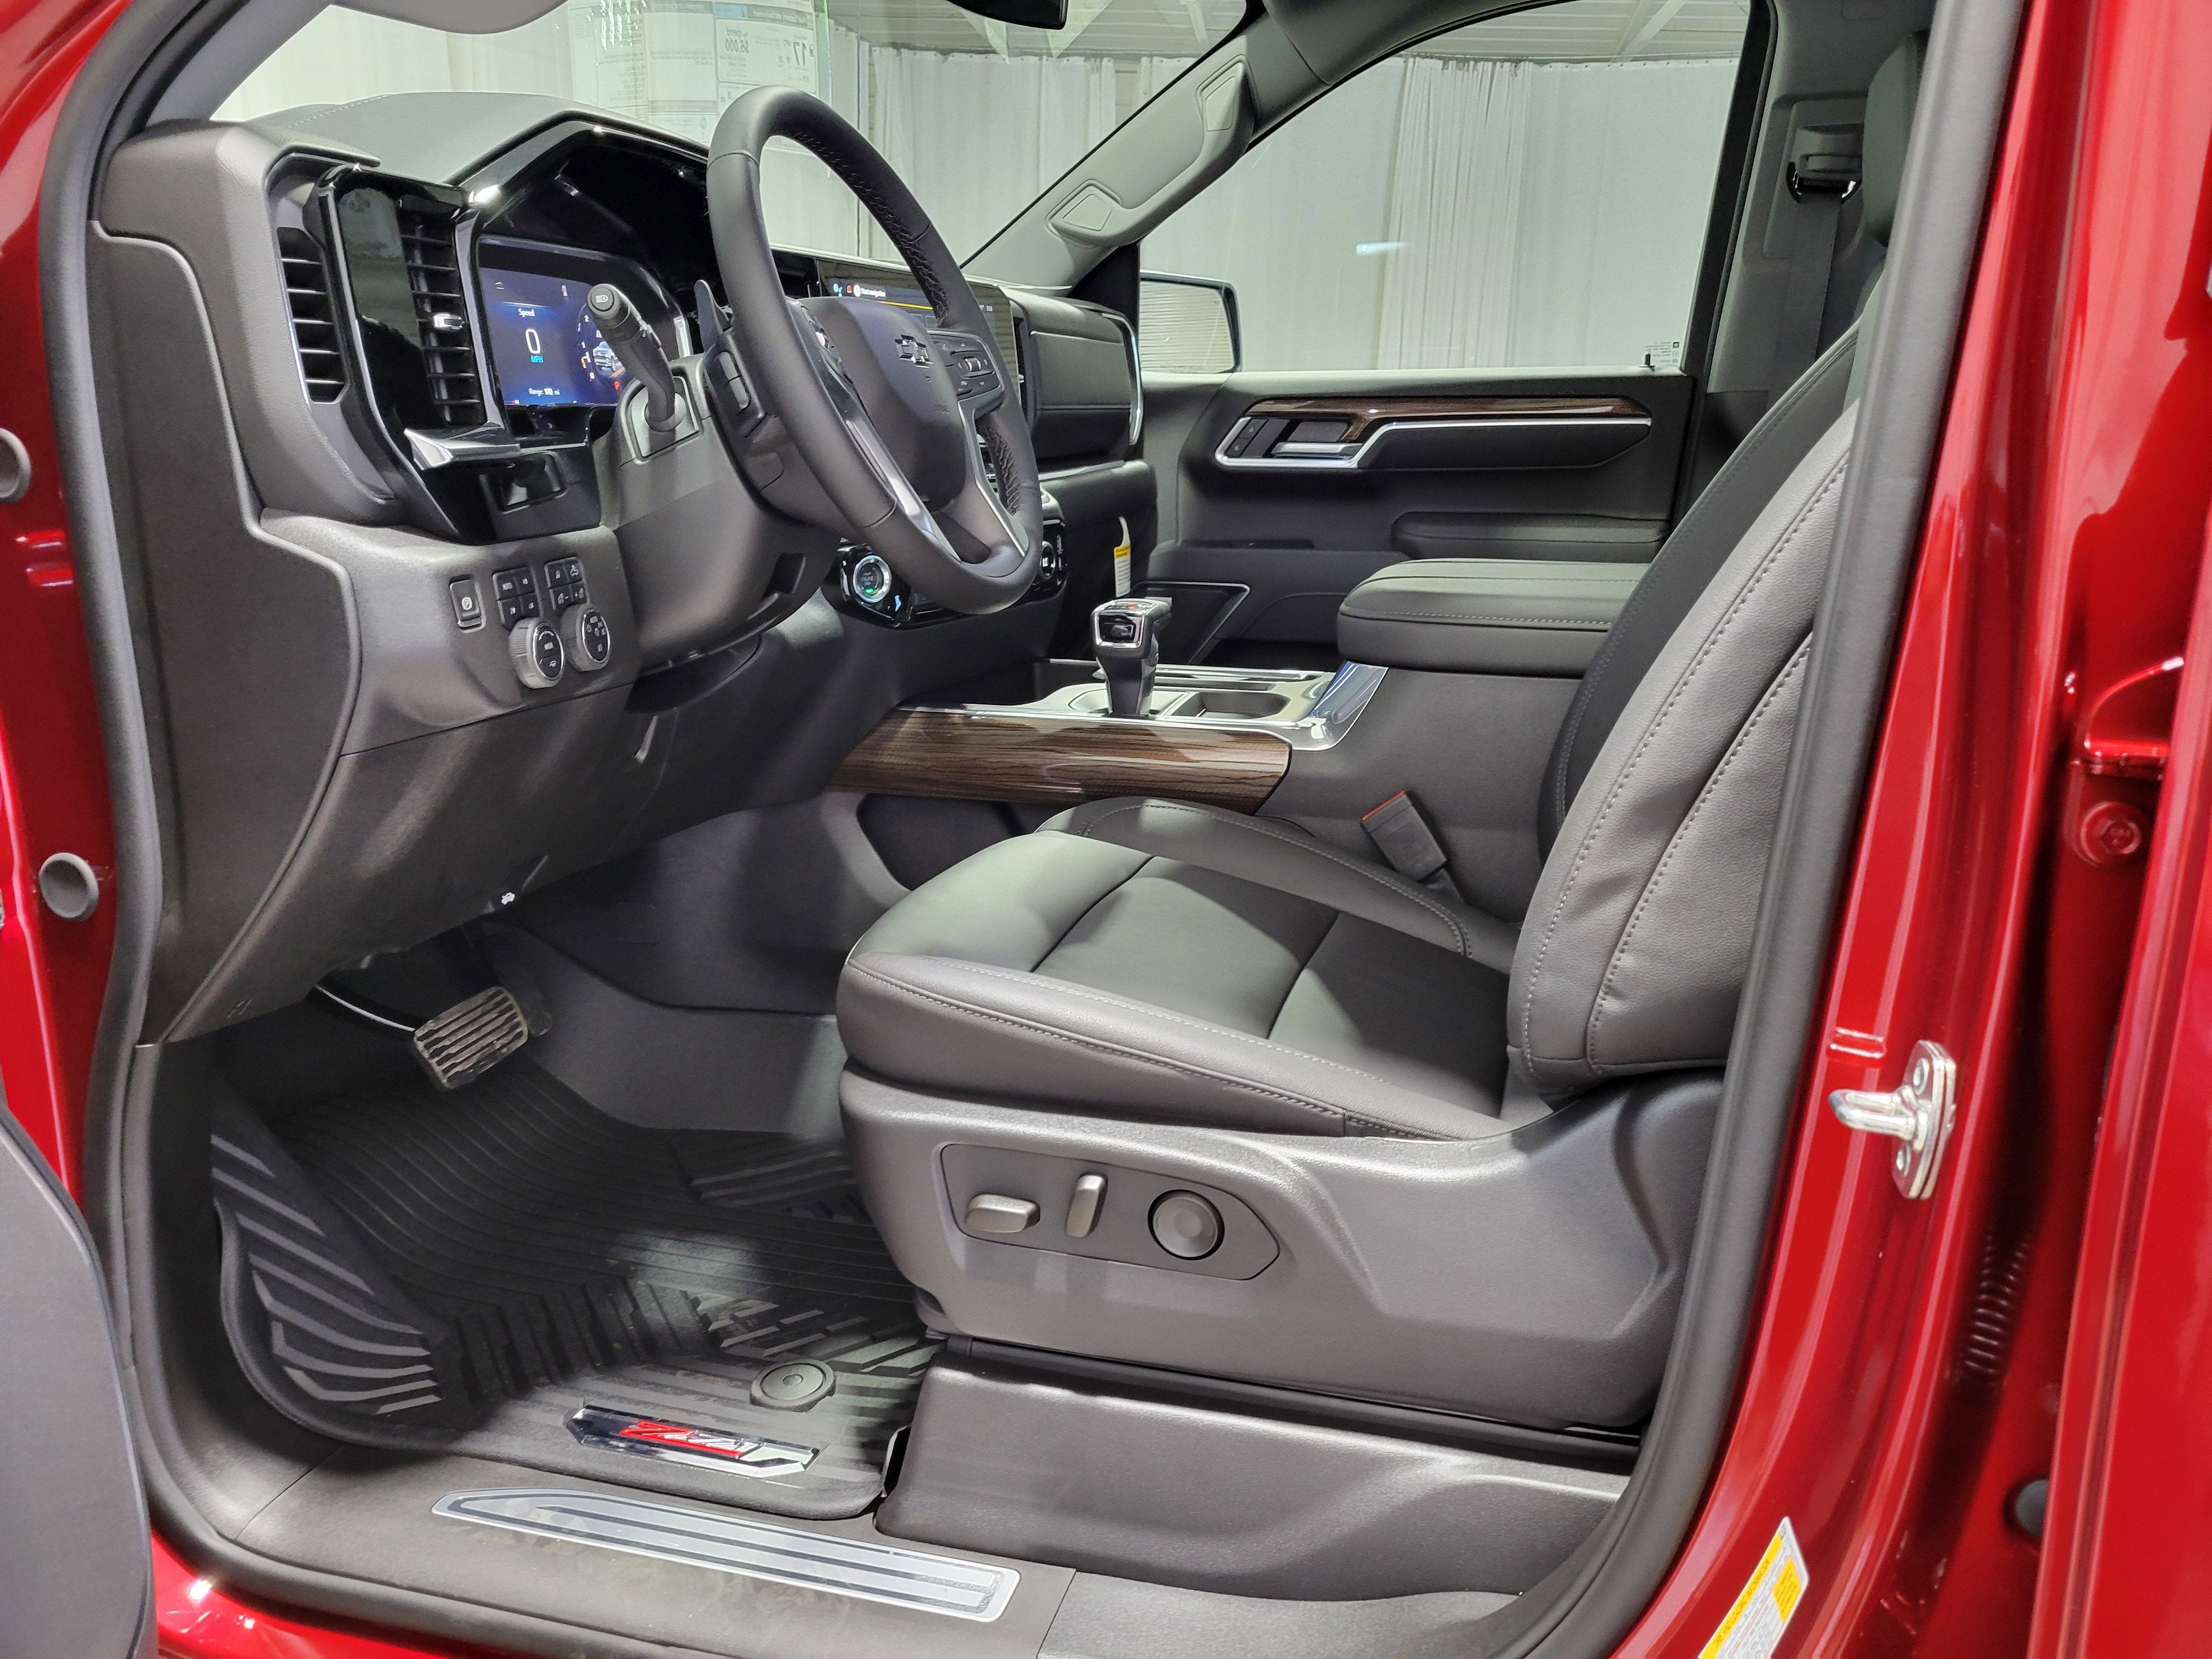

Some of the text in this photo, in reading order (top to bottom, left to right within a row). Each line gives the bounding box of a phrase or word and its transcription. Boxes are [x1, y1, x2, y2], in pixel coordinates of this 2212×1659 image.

[518, 308, 535, 318] Speed
[525, 329, 541, 354] 0
[530, 355, 544, 363] MPH
